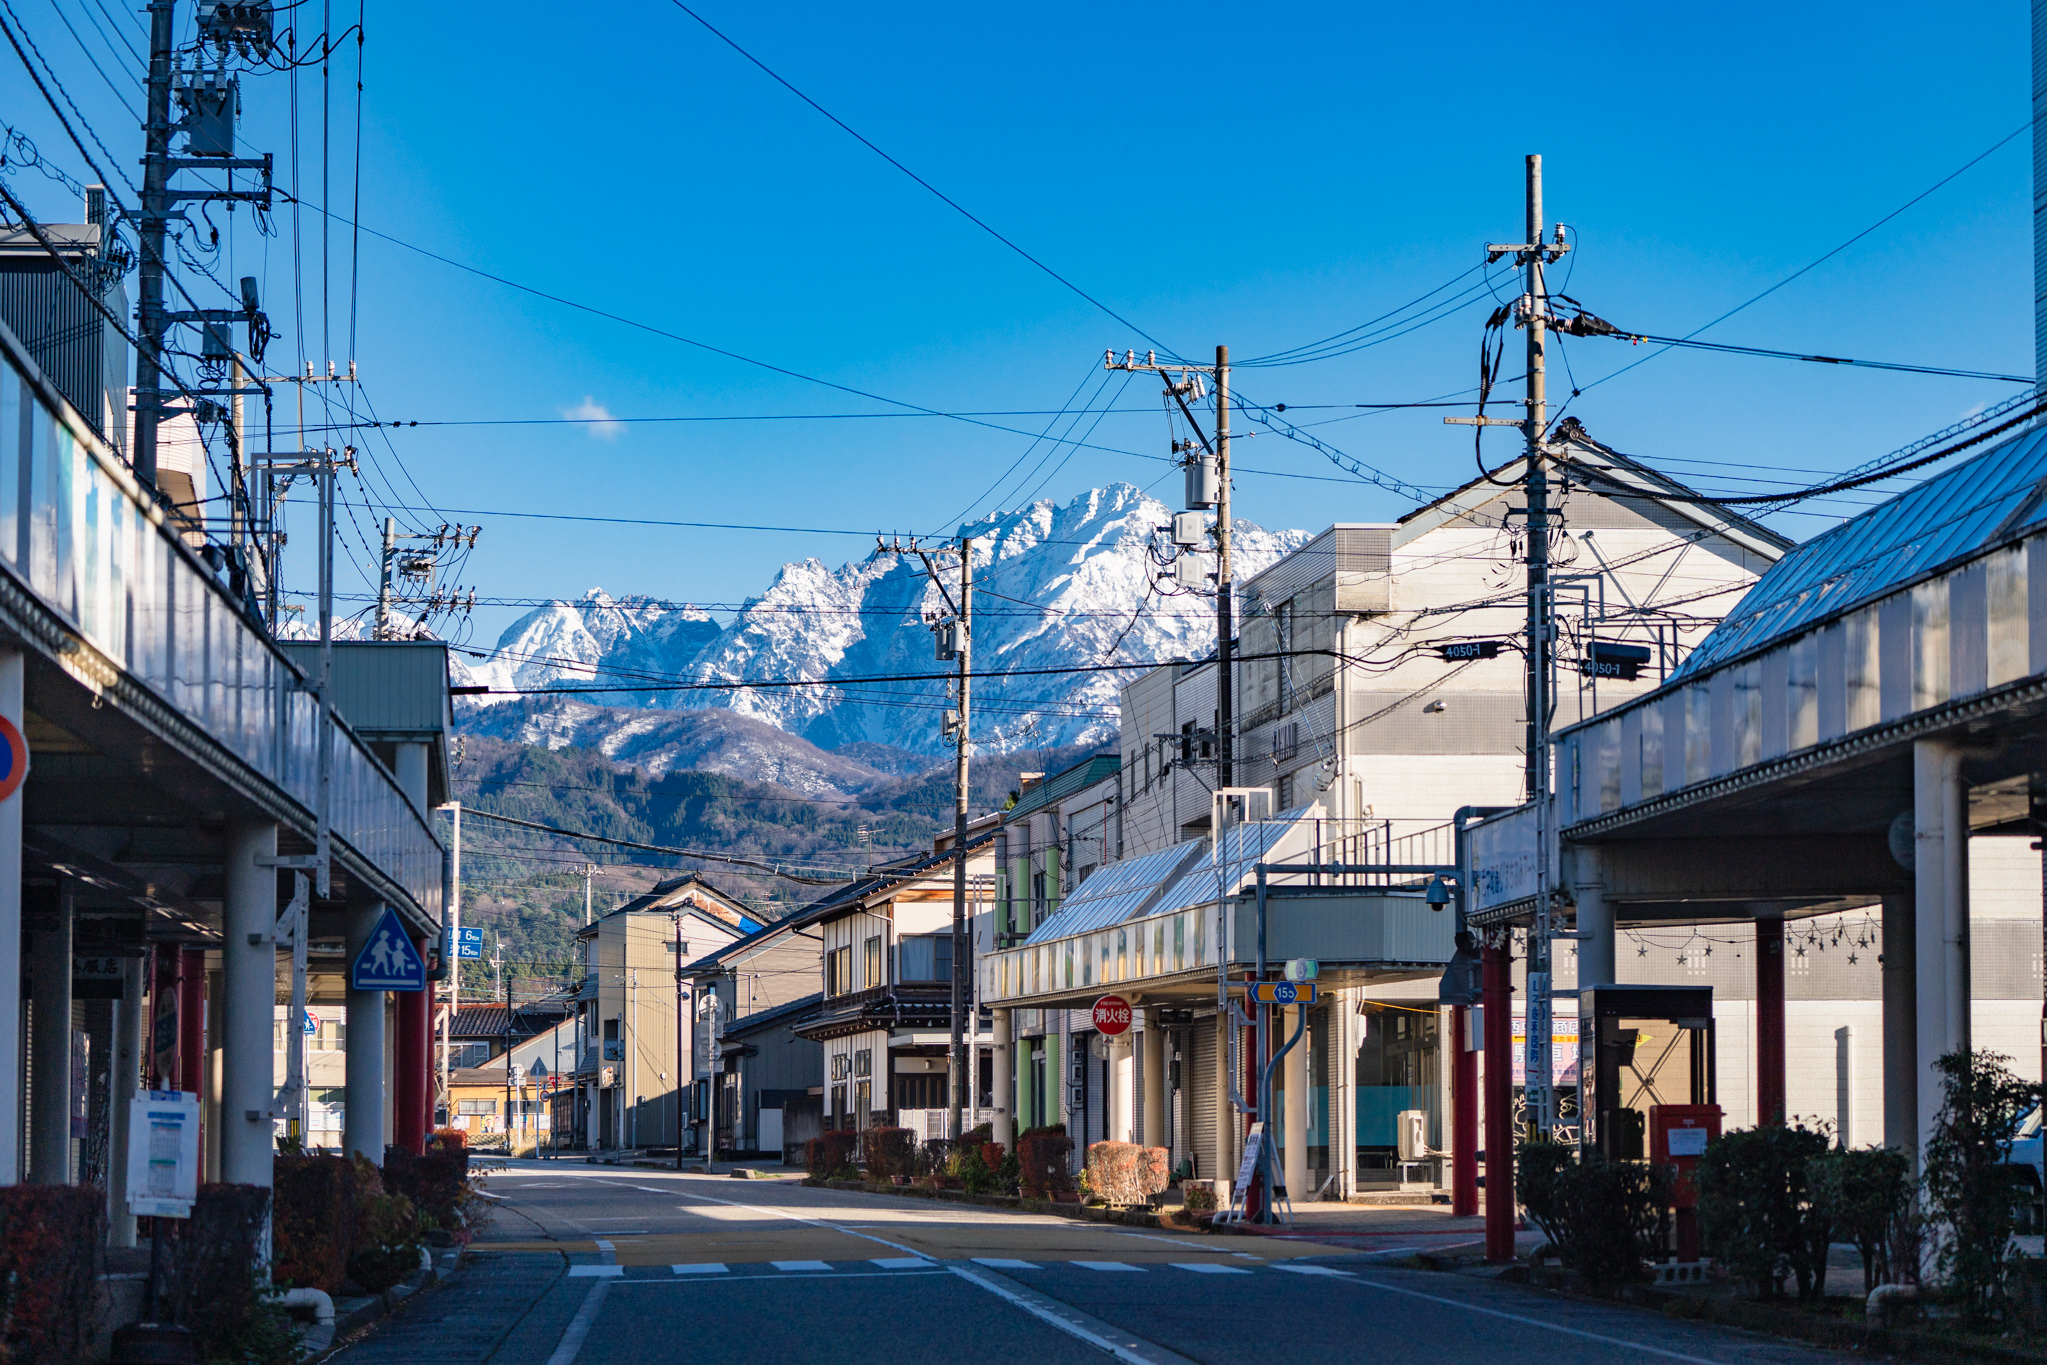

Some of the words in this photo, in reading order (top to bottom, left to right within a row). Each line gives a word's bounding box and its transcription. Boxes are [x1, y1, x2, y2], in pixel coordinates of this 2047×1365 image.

[1446, 644, 1481, 658] 4050-1
[1584, 662, 1620, 675] 4050-1
[1277, 986, 1295, 999] 155
[1095, 1008, 1130, 1023] 消火栓
